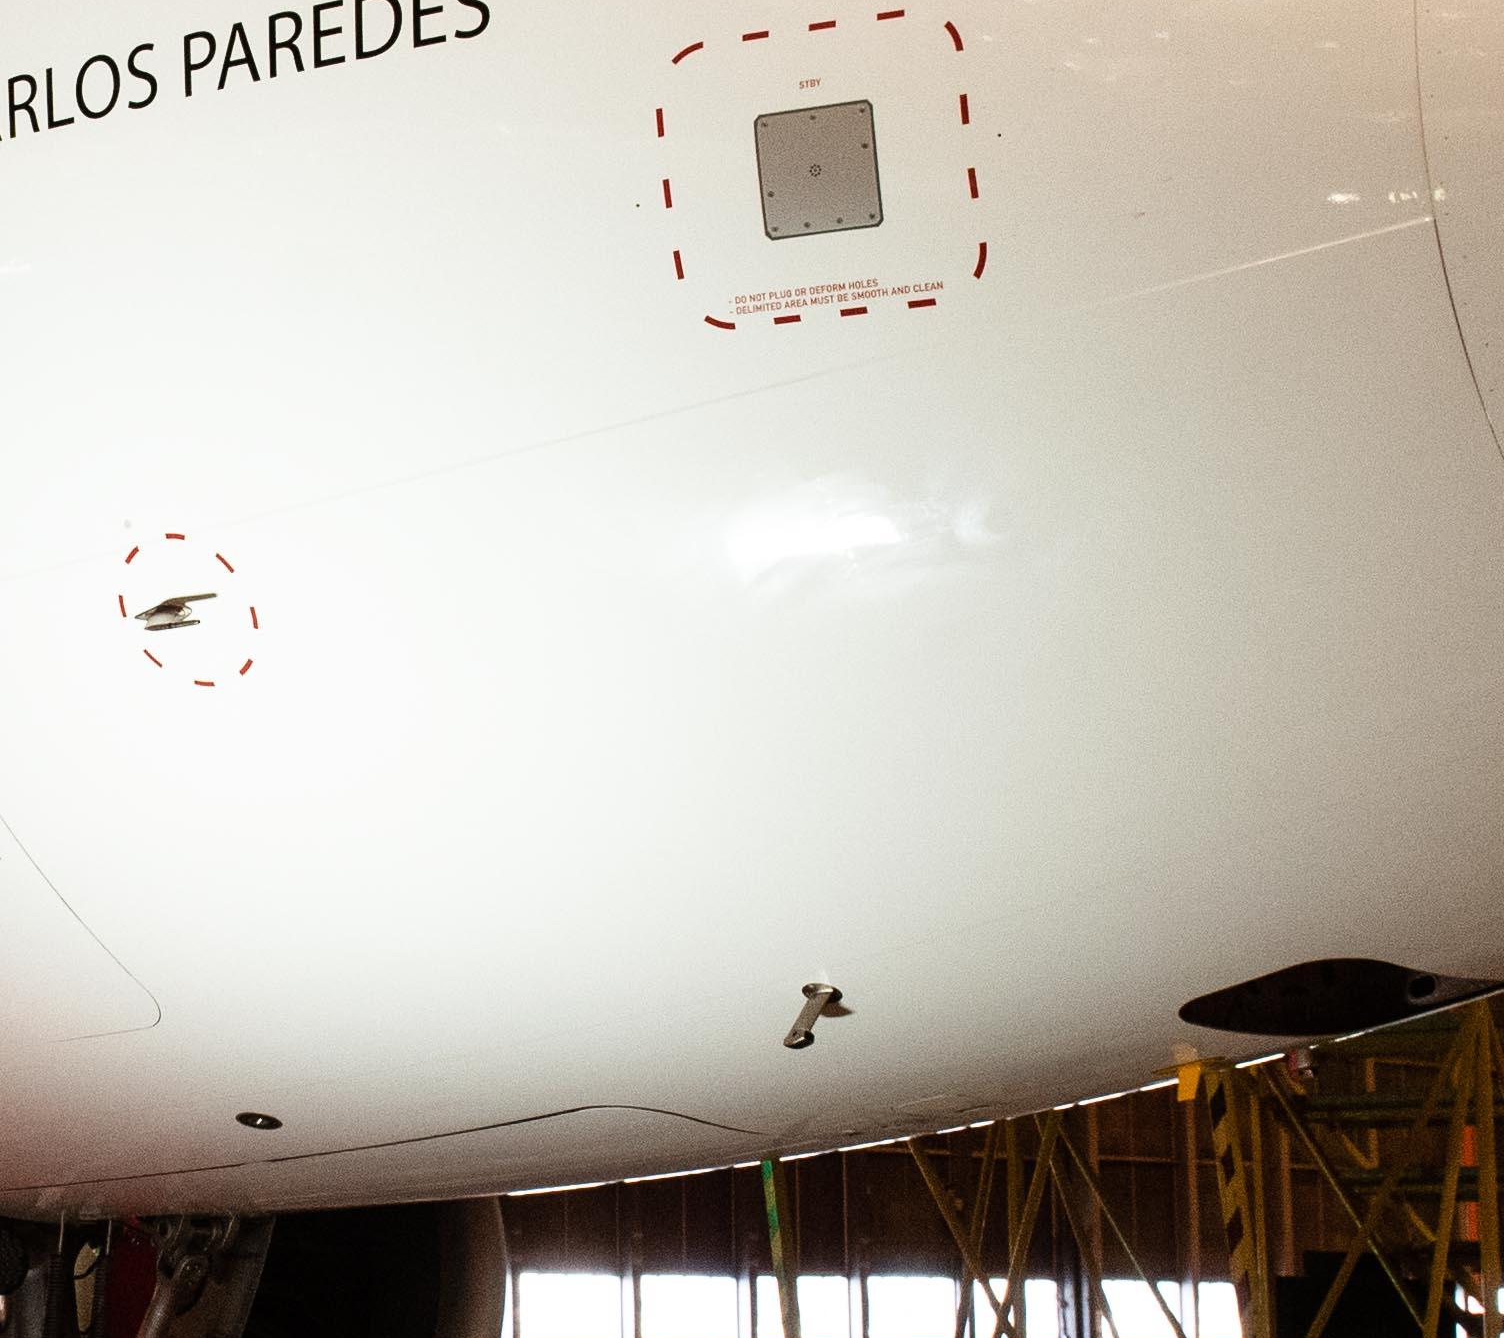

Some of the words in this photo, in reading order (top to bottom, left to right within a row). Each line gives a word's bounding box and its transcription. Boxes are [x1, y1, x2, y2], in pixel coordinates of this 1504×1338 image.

[798, 77, 822, 90] STBY
[735, 294, 747, 305] DO
[749, 292, 767, 303] NOT
[769, 290, 792, 301] PLUG
[795, 288, 807, 298] OR
[809, 284, 846, 296] DEFORM
[848, 279, 879, 291] HOLES
[736, 300, 782, 316] DELIMITED
[784, 297, 808, 309] AREA
[810, 295, 834, 306] MUST
[837, 292, 849, 303] BE
[851, 287, 889, 301] SMOOTH
[892, 286, 911, 297] AND
[913, 281, 944, 294] CLEAN
